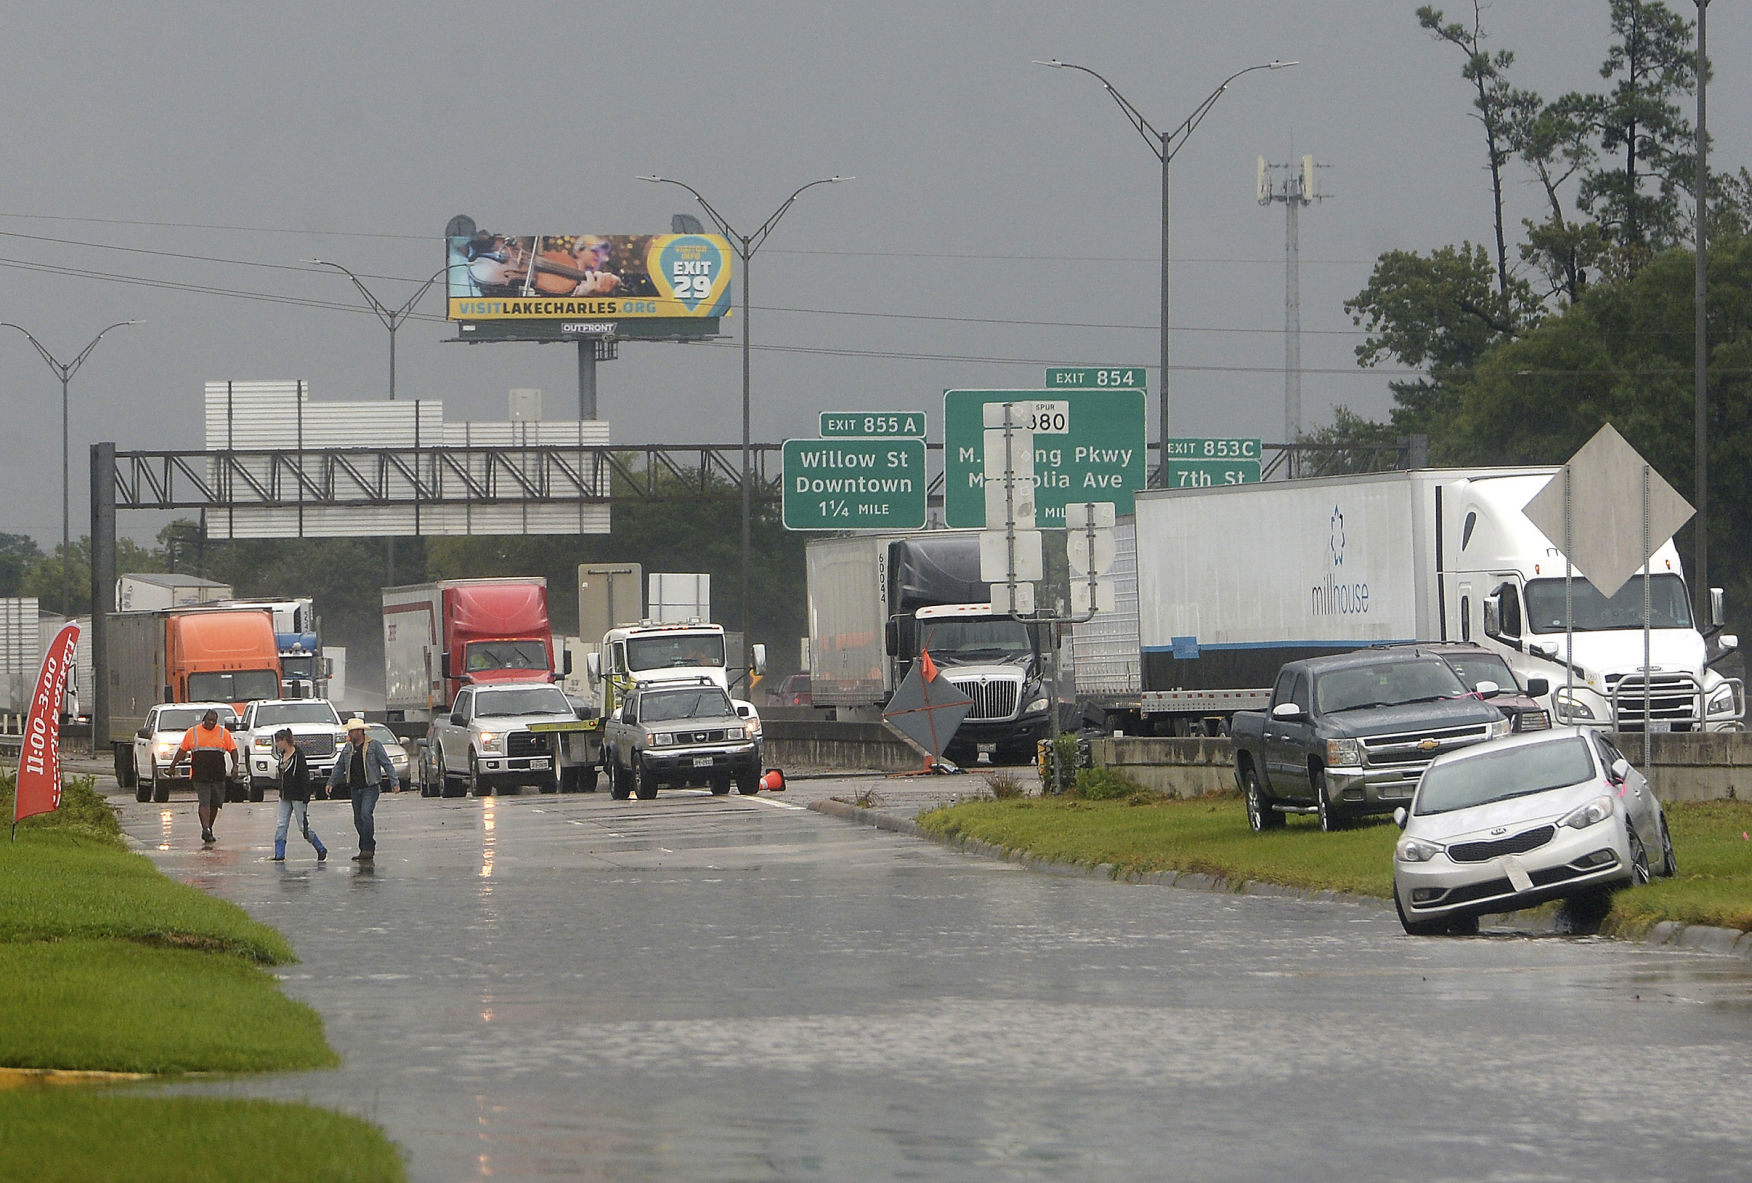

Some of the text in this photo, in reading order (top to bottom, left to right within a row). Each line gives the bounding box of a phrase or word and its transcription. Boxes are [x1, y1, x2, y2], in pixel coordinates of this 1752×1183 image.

[674, 261, 712, 276] EXIT
[674, 276, 712, 299] 29
[459, 302, 656, 314] VISITLAKECHARLES.ORG
[564, 324, 614, 332] OUTFRONT
[1056, 370, 1134, 386] EXIT 854
[828, 420, 856, 430] EXIT
[1168, 441, 1254, 456] EXIT 853C
[800, 450, 908, 468] Willow St
[1035, 449, 1061, 468] ng
[1075, 446, 1132, 468] Pkwy
[796, 476, 912, 493] Downtown
[968, 472, 1122, 488] Molia Ave
[1177, 470, 1245, 488] 7th St
[858, 504, 890, 514] MILE
[1045, 507, 1067, 518] MIL
[1312, 572, 1369, 616] millhouse
[26, 656, 56, 776] 11:00-3:00
